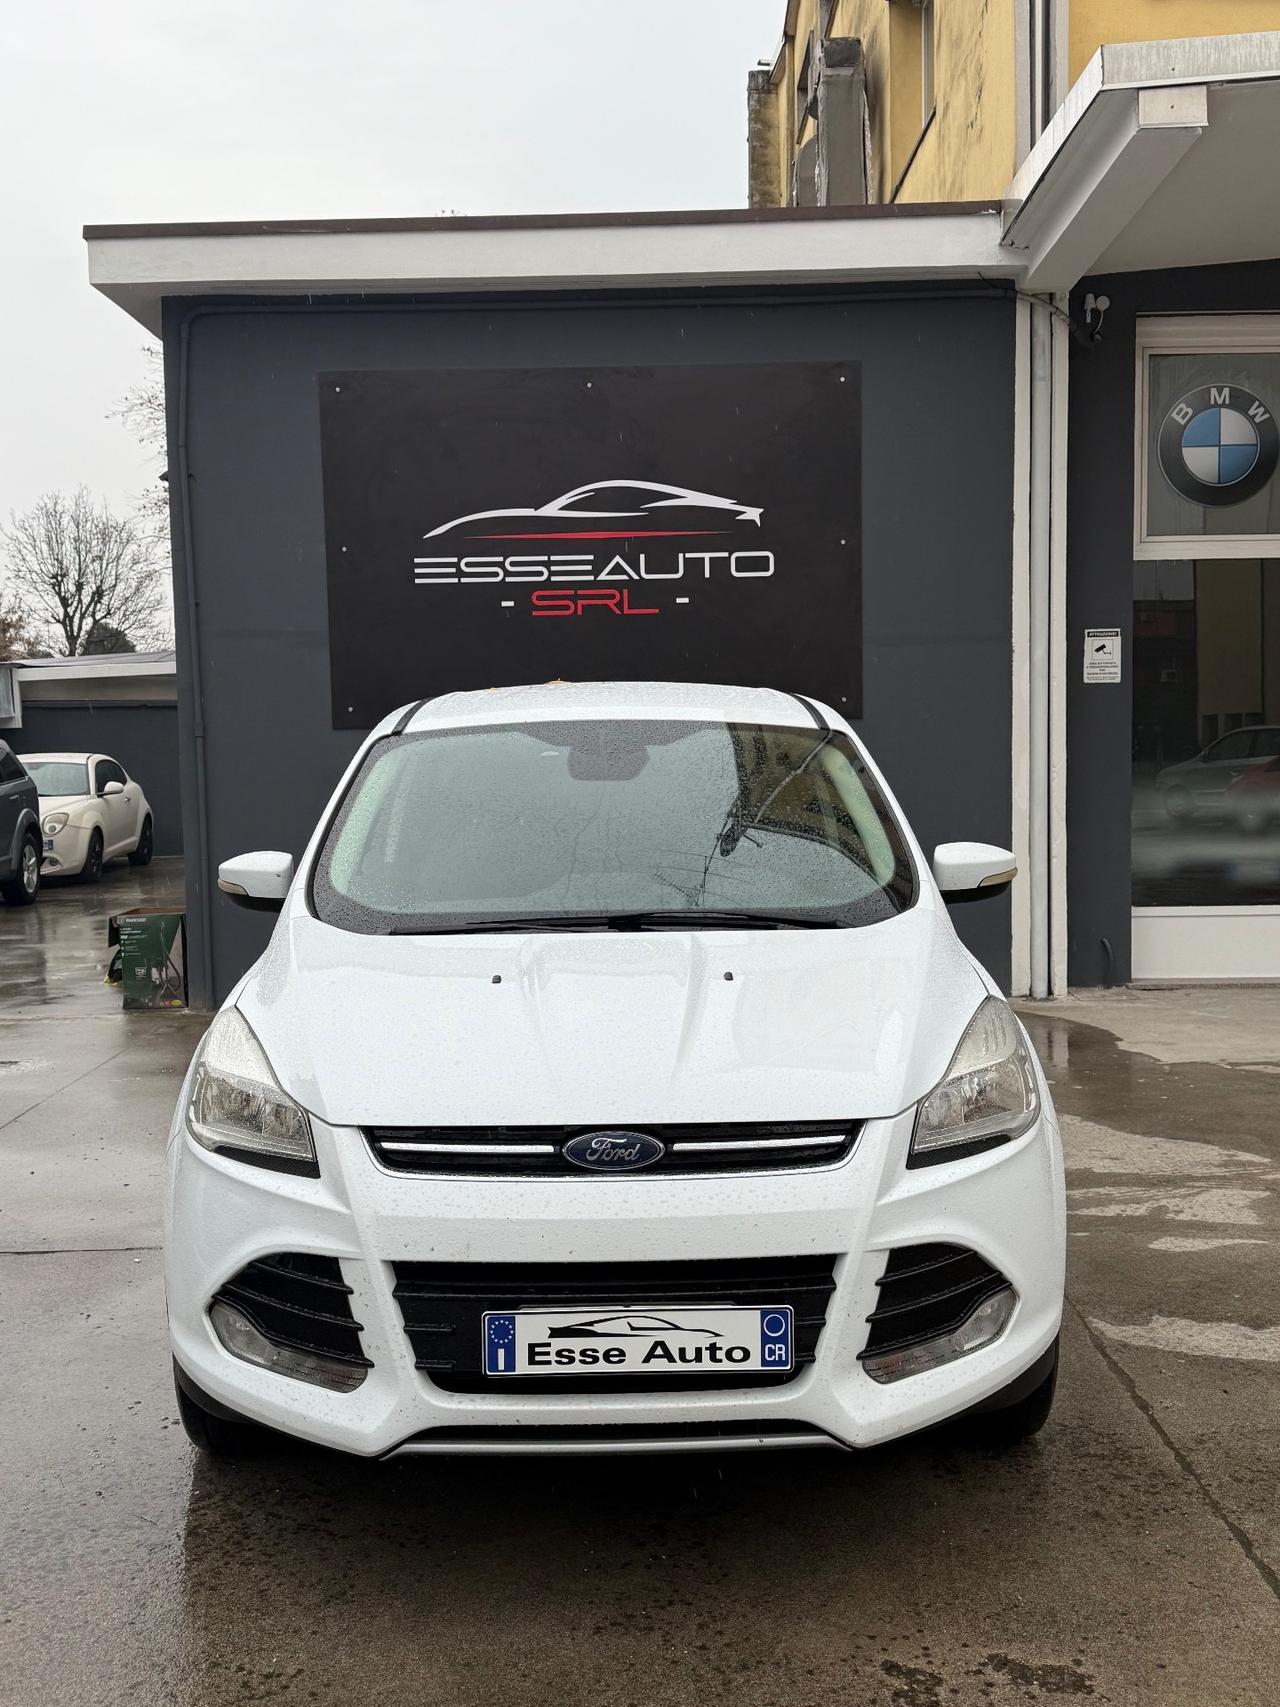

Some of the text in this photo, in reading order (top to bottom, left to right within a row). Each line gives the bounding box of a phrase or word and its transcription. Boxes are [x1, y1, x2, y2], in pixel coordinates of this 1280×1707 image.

[1171, 387, 1270, 426] BMW
[414, 551, 774, 583] ESSEAUTO
[531, 588, 659, 616] SRL
[586, 1137, 641, 1160] Ford
[527, 1340, 751, 1366] Esse Auto
[764, 1343, 786, 1361] CR
